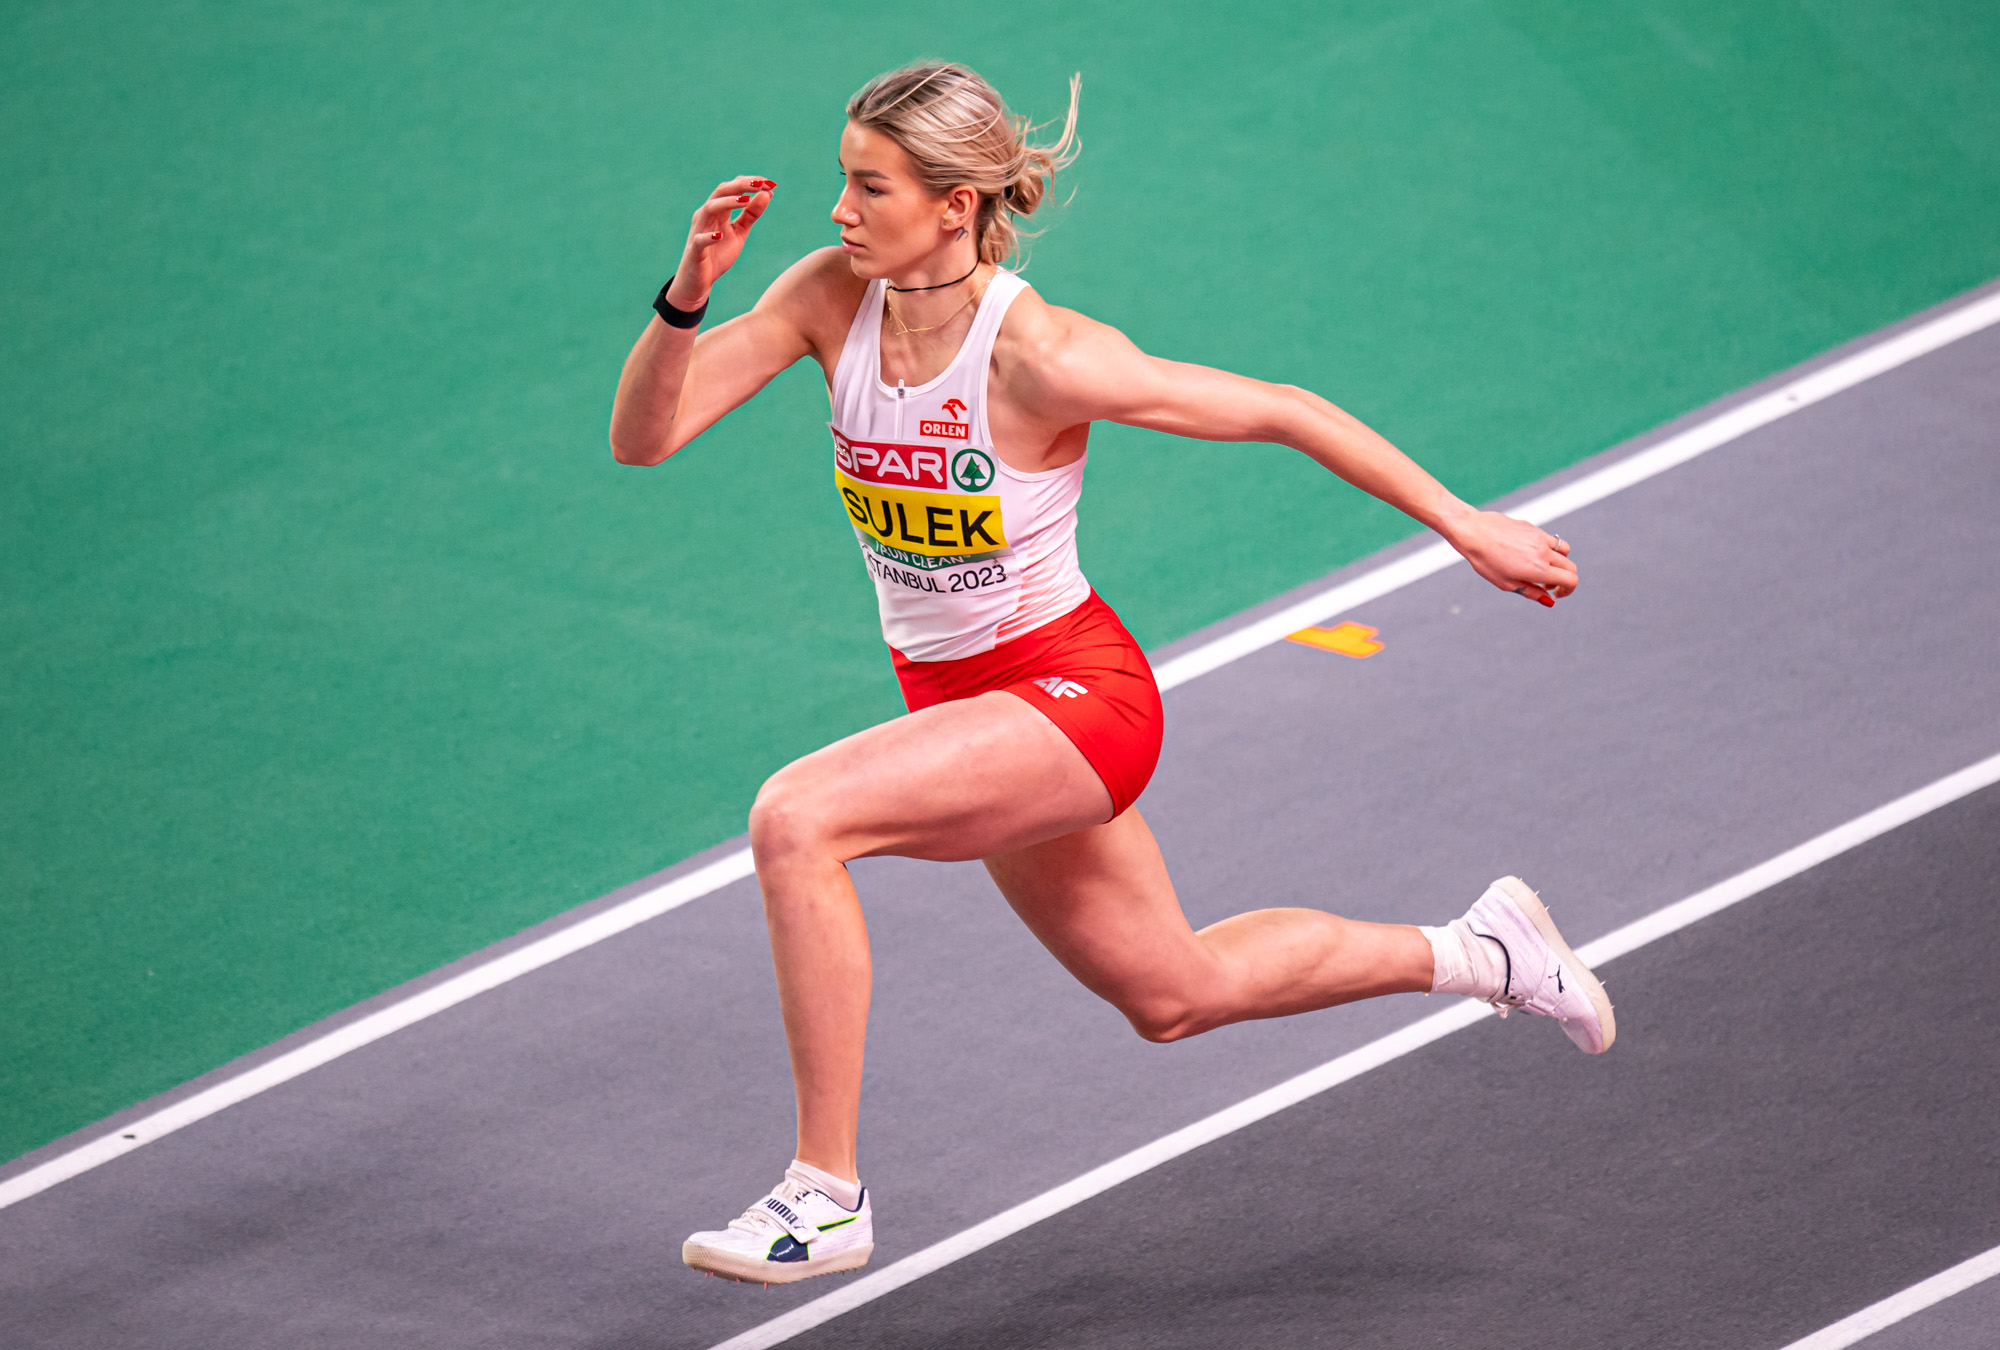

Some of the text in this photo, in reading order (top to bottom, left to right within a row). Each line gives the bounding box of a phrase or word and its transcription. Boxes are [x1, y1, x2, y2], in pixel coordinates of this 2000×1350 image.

[922, 423, 966, 437] ORLEN
[835, 435, 944, 484] SPAR
[842, 486, 1000, 548] SULEK
[880, 546, 909, 563] RUN
[948, 564, 1008, 593] 2023
